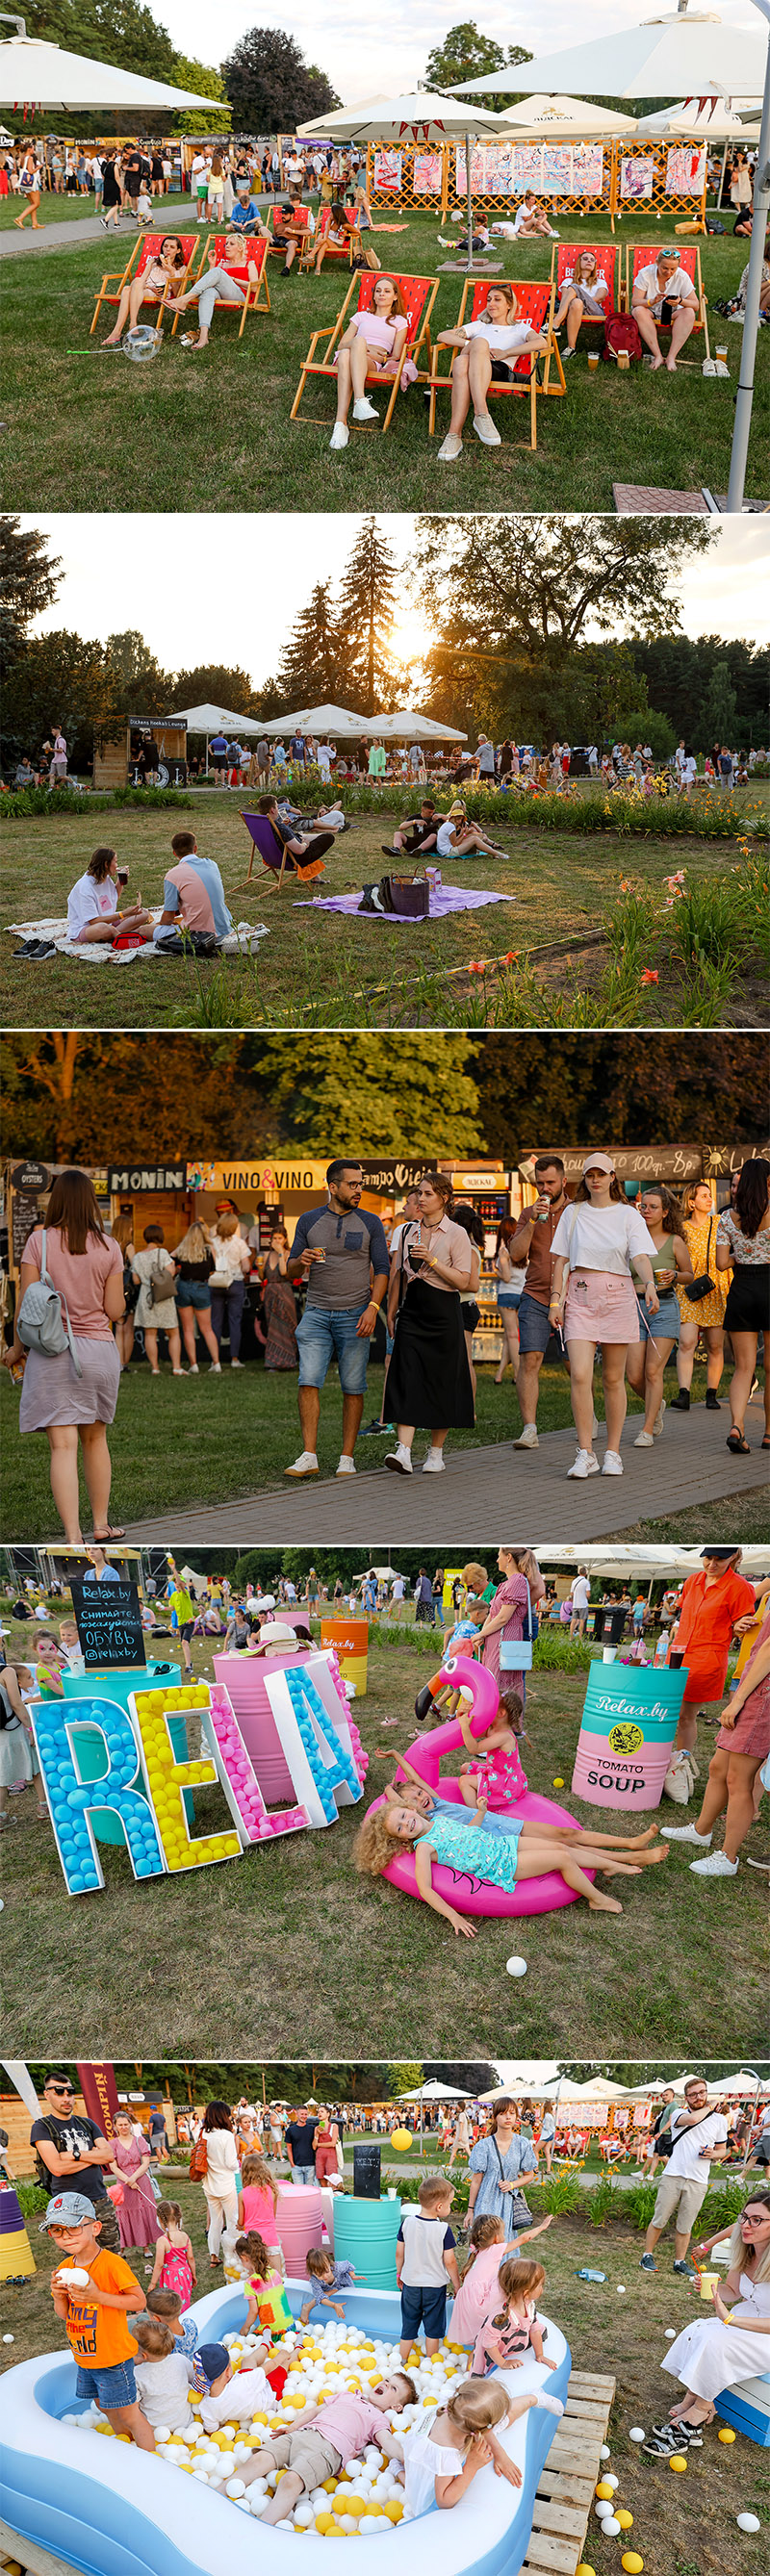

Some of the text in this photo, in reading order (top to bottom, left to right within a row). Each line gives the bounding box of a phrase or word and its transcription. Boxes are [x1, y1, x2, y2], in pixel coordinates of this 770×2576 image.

[82, 1586, 131, 1601] Relax.by
[86, 1630, 135, 1645] ОБУВЬ
[322, 1638, 355, 1650] Relax.by
[85, 1647, 138, 1660] @relaxby
[595, 1696, 668, 1722] Relax.by
[28, 1651, 367, 1896] RELA
[597, 1759, 644, 1773] TOMATO
[587, 1771, 646, 1794] SOUP
[67, 2303, 98, 2329] ing
